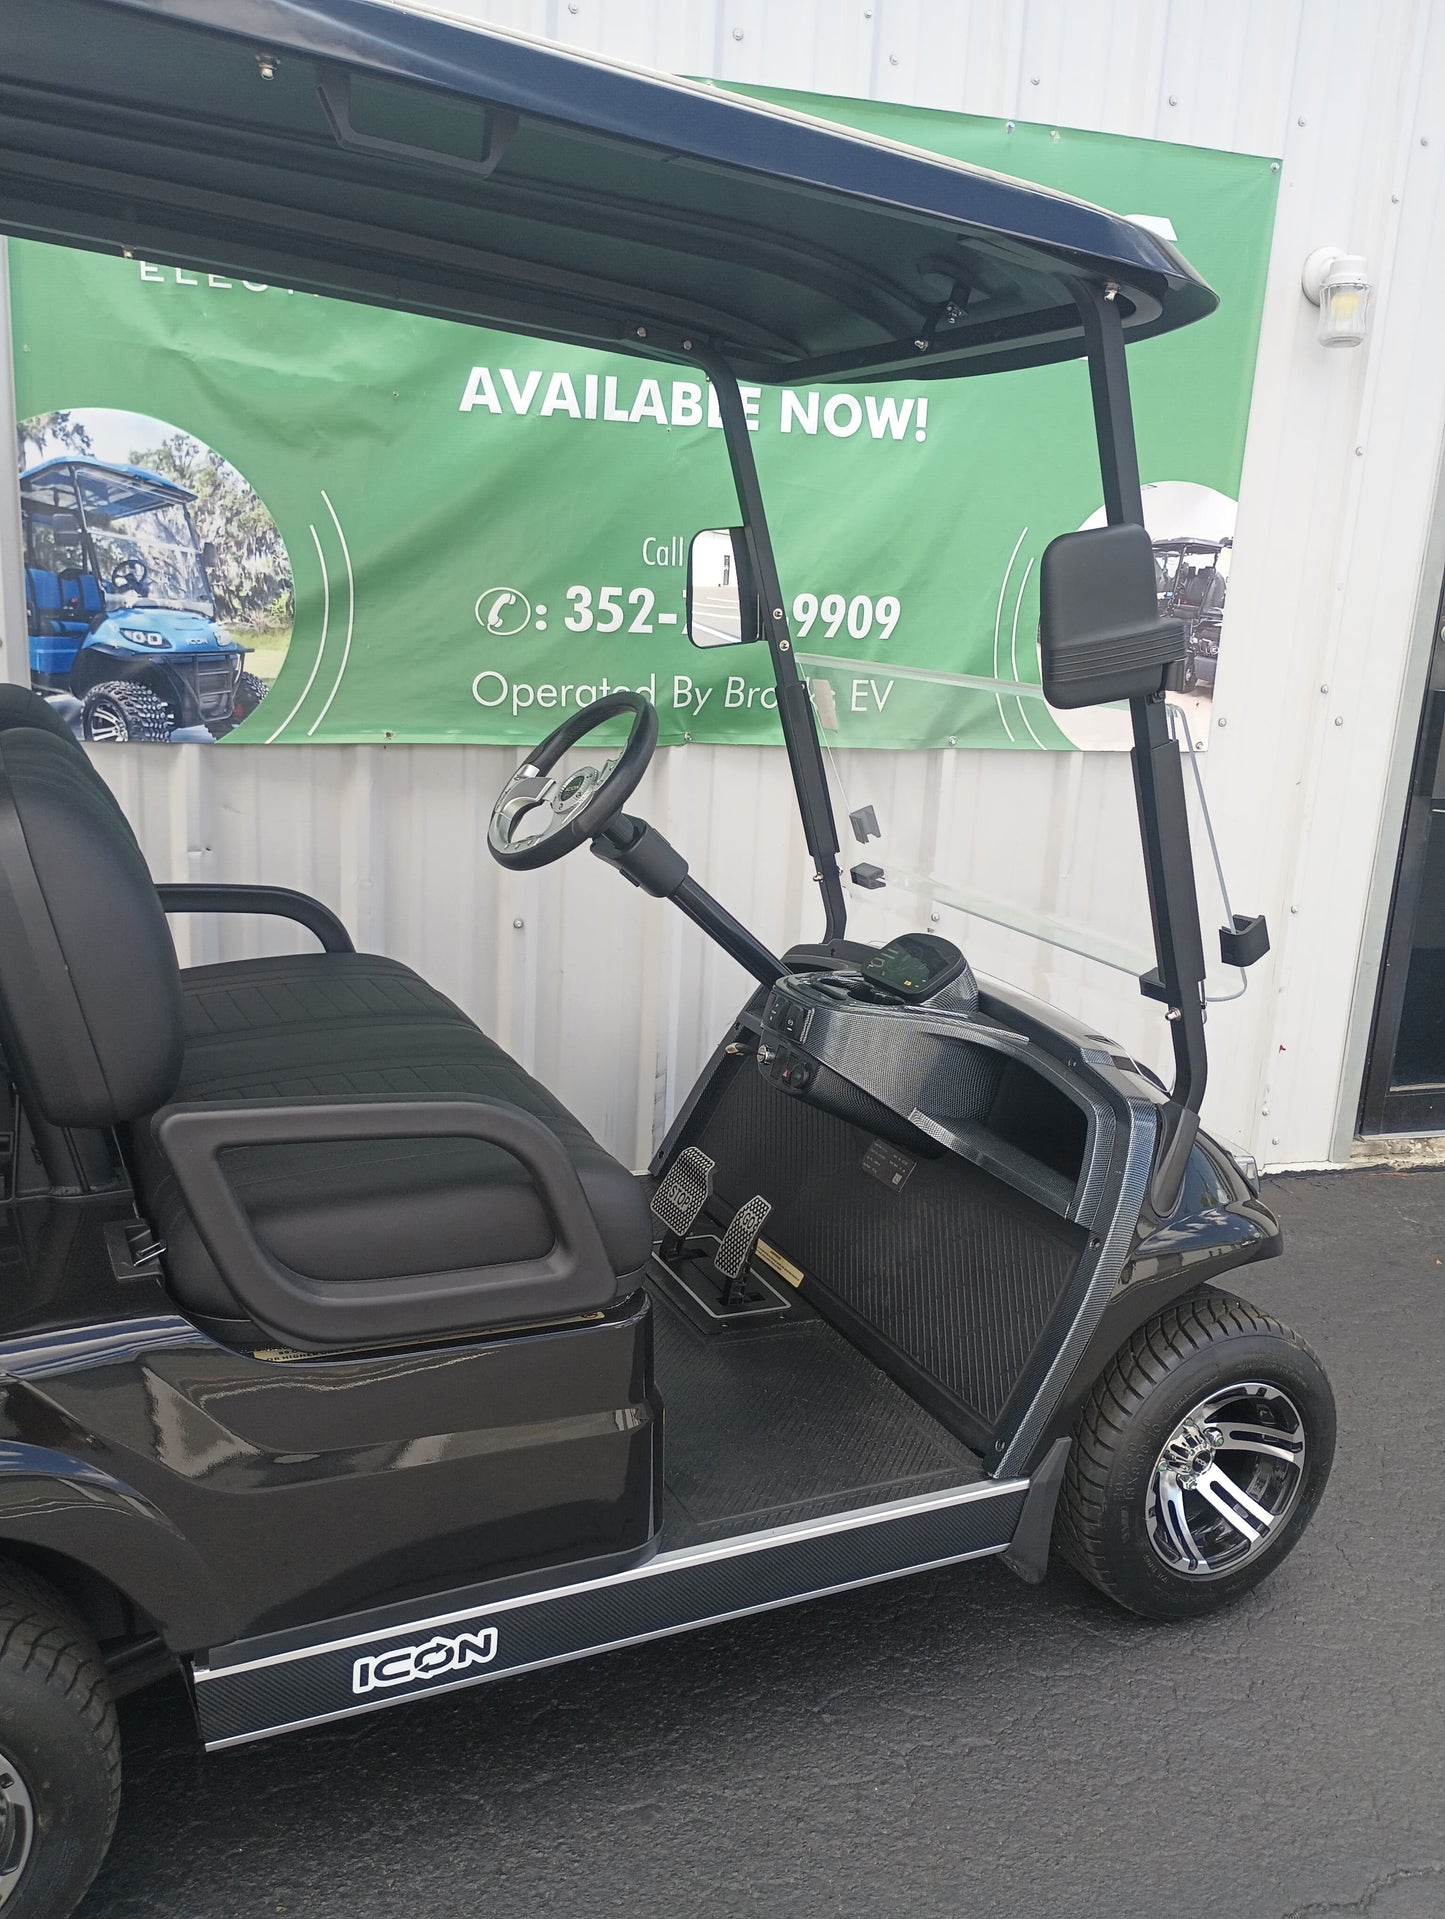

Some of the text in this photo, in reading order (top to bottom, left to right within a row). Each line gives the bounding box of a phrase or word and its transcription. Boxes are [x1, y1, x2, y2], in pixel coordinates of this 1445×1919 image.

[459, 366, 929, 443] AVAILABLE NOW!
[642, 536, 684, 567] Call
[673, 675, 712, 715] By
[851, 679, 895, 713] EV
[669, 1184, 691, 1208] STOP
[353, 1627, 499, 1694] ICON
